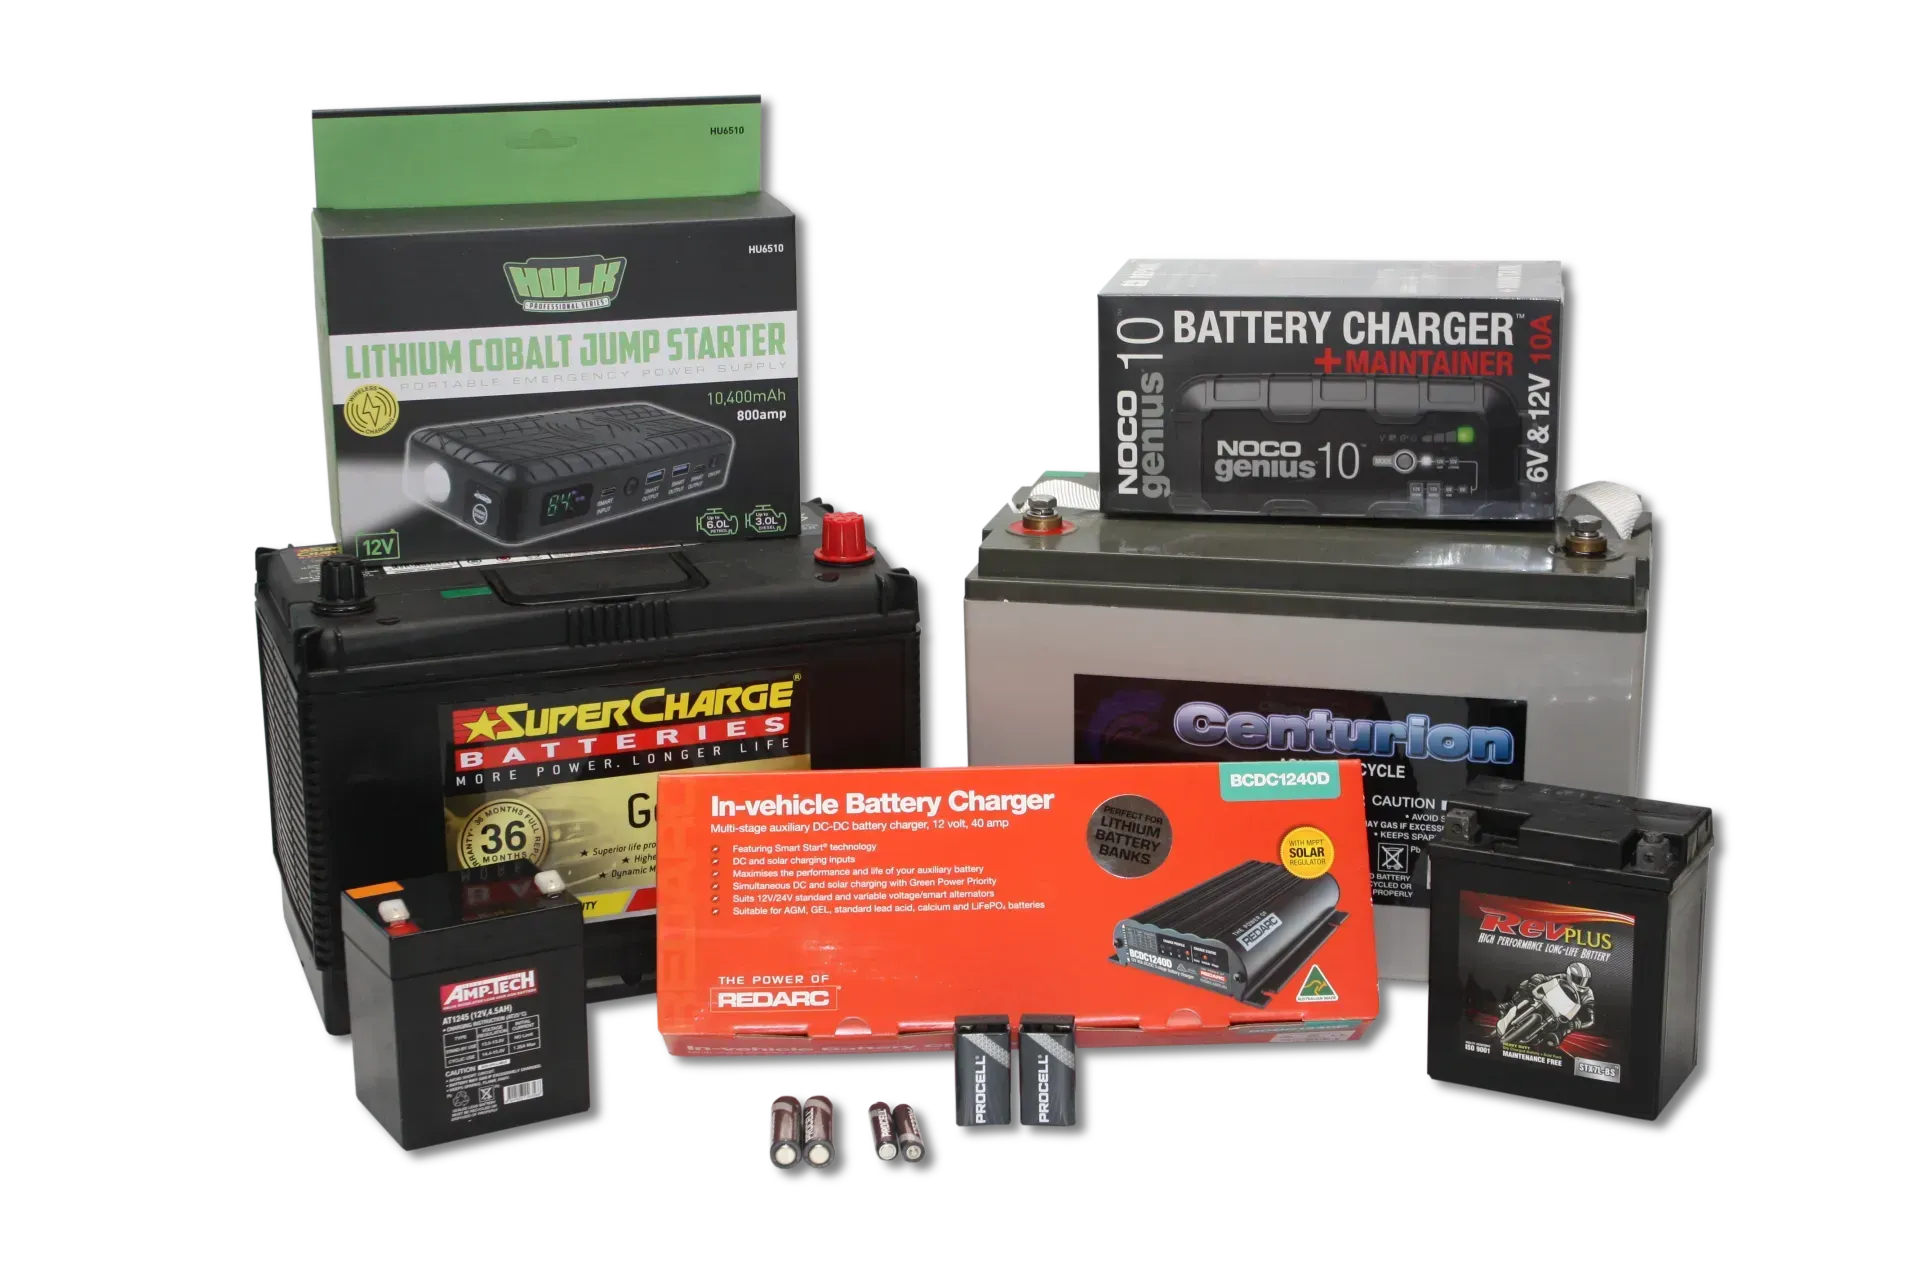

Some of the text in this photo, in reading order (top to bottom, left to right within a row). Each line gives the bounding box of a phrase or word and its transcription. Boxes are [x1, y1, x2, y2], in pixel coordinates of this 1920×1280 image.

[710, 126, 744, 135] HU6510
[748, 244, 785, 254] HU6510
[509, 260, 622, 298] HULK
[529, 299, 605, 310] PROFESSIONAL SERIES
[1174, 310, 1331, 344] BATTERY
[345, 322, 787, 380] LITHIUM COBALT JUMP STARTER
[1116, 317, 1164, 369] 10
[400, 361, 788, 391] PORTABLE EMERGENCY POWER SUPPLY
[348, 386, 378, 402] WIRELESS
[707, 389, 787, 406] 10,400mAh
[1526, 314, 1552, 483] 6V & 12V 10A
[737, 409, 788, 421] 800amp
[365, 418, 395, 434] CHARGING
[1117, 390, 1138, 495] NOCO
[1140, 371, 1171, 499] genius
[1217, 440, 1360, 480] NOCO 10
[1214, 458, 1317, 482] genius
[706, 520, 729, 529] 6.0L
[755, 516, 778, 526] 3.0L
[362, 537, 394, 557] 12V
[1173, 701, 1514, 764] Centurion
[460, 716, 785, 770] BATTERIES
[456, 738, 790, 787] MORE POWER. LONGER LIFE
[1230, 772, 1330, 787] BCDC1240D
[711, 790, 1055, 817] In-vehicle Battery Charger
[1371, 795, 1436, 810] CAUTION
[485, 806, 523, 818] MONTHS
[524, 813, 540, 834] FULL
[1104, 805, 1163, 825] PERFECT FOR
[1412, 814, 1438, 822] AVOID
[710, 819, 1009, 834] Multi-stage auxiliary DC-DC battery charger, 12 volt, 40 amp
[1101, 816, 1161, 839] LITHIUM
[1381, 821, 1398, 829] GAS
[481, 820, 527, 855] 36
[1095, 828, 1161, 852] BATTERY
[1288, 838, 1324, 847] WITH MPPT
[1381, 831, 1409, 840] KEEPS
[592, 846, 626, 858] Superior
[628, 841, 641, 852] life
[733, 844, 772, 854] Featuring
[775, 844, 801, 853] Smart
[830, 843, 877, 853] technology
[1099, 843, 1151, 865] BANKS
[1289, 847, 1325, 858] SOLAR
[483, 851, 527, 863] MONTHS
[733, 855, 855, 867] DC and solar charging inputs
[1290, 858, 1326, 866] REGULATOR
[611, 866, 648, 880] Dynamic
[733, 865, 984, 879] Maximises the performance and life of your auxiliary battery
[1376, 873, 1410, 882] BATTERY
[733, 877, 997, 891] Simultaneous DC and solar charging with Green Power Priority
[1400, 882, 1412, 890] OR
[733, 890, 995, 903] Suits 12V/24V standard and variable voltage/smart alternators
[1372, 889, 1413, 898] PROPERLY
[733, 906, 768, 915] Suitable
[770, 906, 782, 914] for
[784, 906, 809, 916] AGM,
[811, 906, 832, 915] GEL,
[834, 905, 872, 914] standard
[874, 904, 892, 913] lead
[894, 904, 915, 913] acid,
[917, 903, 950, 912] calcium
[953, 902, 969, 911] and
[1008, 901, 1046, 910] batteries
[1242, 916, 1279, 947] REDARC
[1478, 932, 1611, 962] HIGH PERFORMANCE LONG-LIFE BATTERY
[718, 974, 830, 985] THE POWER OF
[717, 990, 830, 1008] REDARC
[442, 1013, 470, 1026] AT1245
[1465, 1044, 1475, 1052] ISO
[1502, 1049, 1545, 1063] MAINTENANCE
[1547, 1057, 1562, 1067] FREE
[445, 1066, 476, 1078] CAUTION
[975, 1055, 986, 1124] PROCELL
[1038, 1054, 1050, 1123] PROCELL
